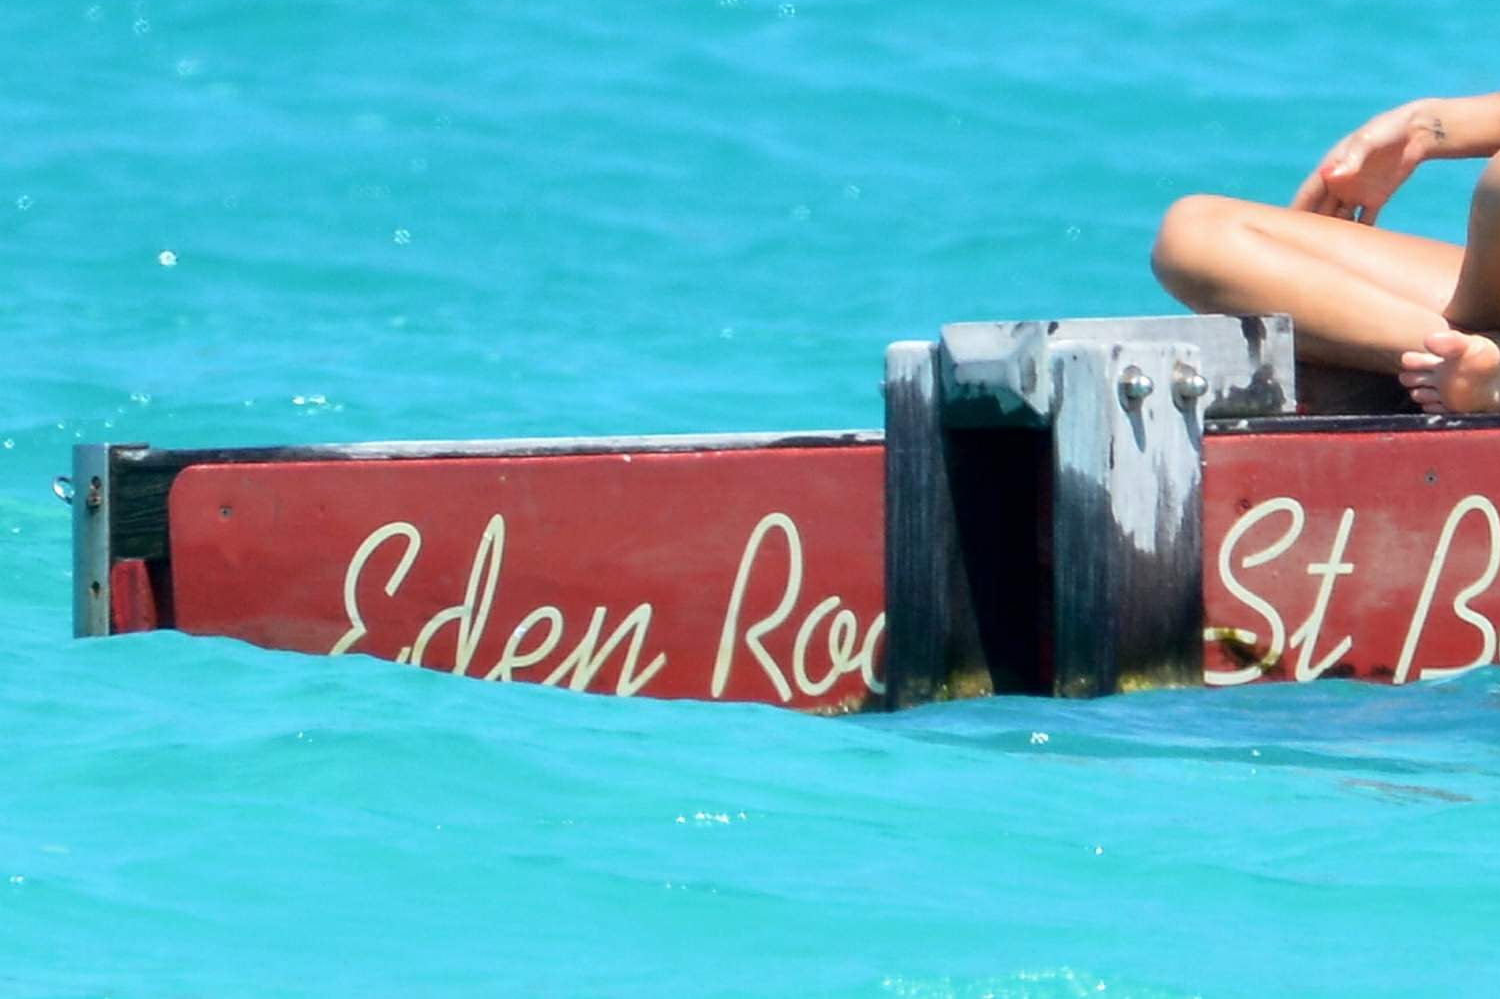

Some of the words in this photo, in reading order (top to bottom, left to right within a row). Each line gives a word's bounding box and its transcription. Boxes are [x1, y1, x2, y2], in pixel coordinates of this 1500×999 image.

[329, 513, 667, 697] Eden
[710, 512, 887, 702] Roc
[1203, 497, 1355, 686] St
